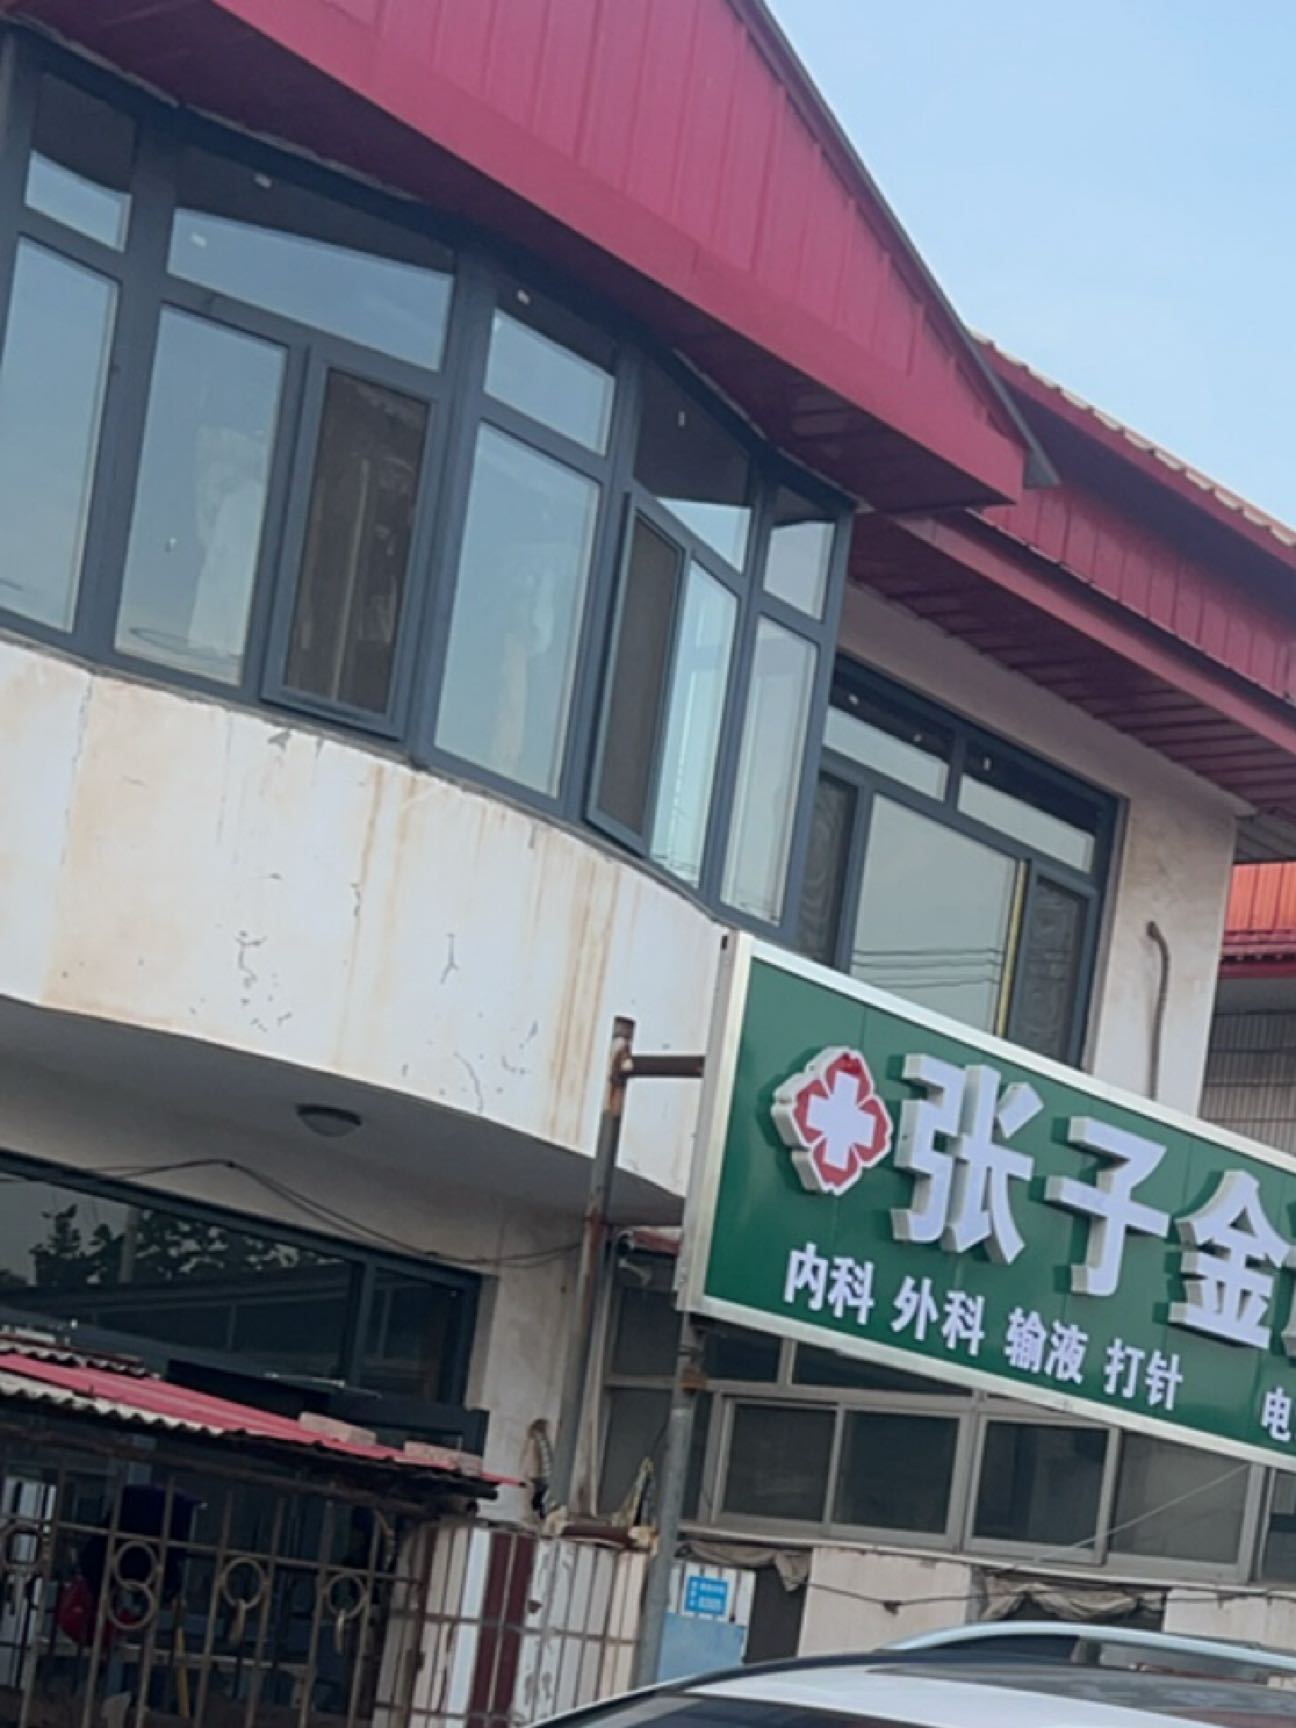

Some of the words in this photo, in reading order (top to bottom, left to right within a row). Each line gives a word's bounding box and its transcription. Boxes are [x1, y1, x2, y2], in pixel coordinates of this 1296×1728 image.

[783, 1241, 874, 1325] 内科
[891, 1275, 985, 1356] 外科
[1004, 1307, 1089, 1384] 输液
[1103, 1338, 1183, 1411] 打针
